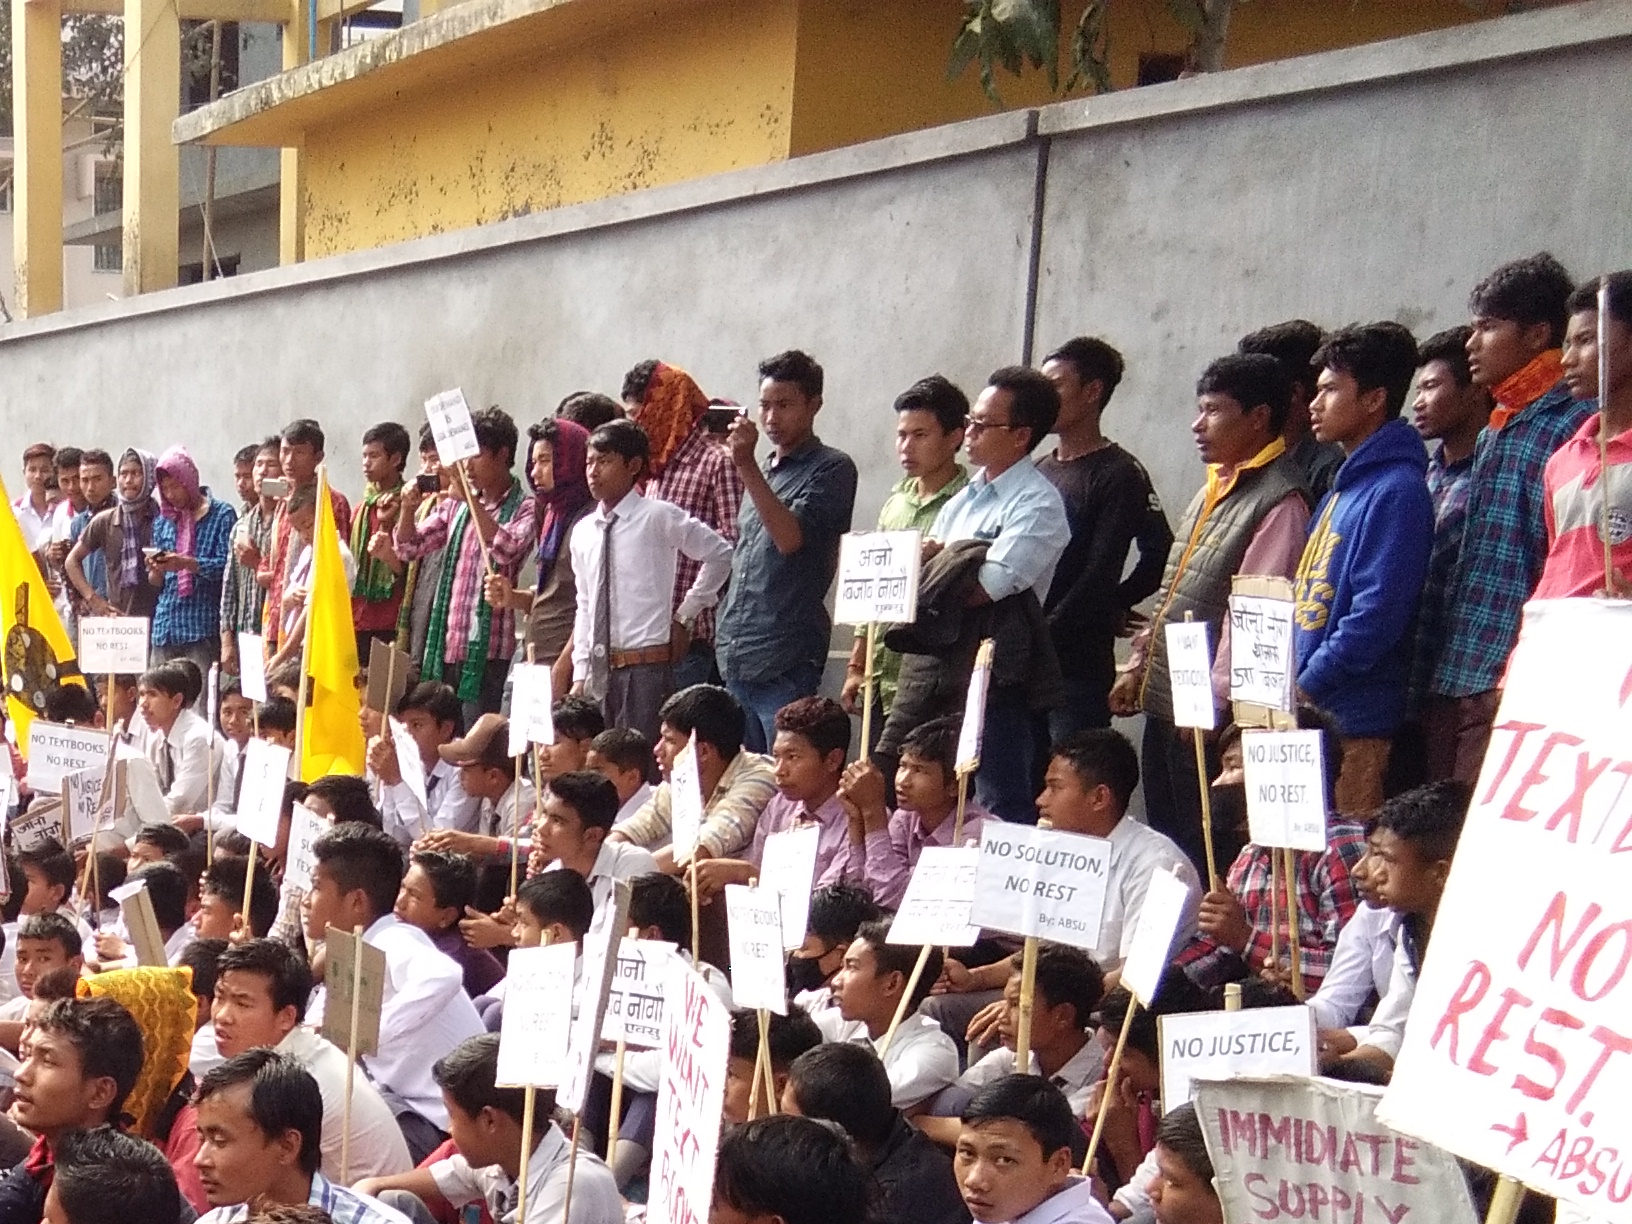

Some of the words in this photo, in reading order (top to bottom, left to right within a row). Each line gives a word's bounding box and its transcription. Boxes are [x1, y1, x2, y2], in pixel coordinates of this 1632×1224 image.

[83, 628, 95, 636] NO
[96, 642, 108, 651] NO
[31, 734, 47, 745] NO
[46, 754, 61, 766] NO
[1248, 744, 1265, 763] NO
[1259, 785, 1277, 803] NO
[984, 840, 1012, 857] NO
[1015, 845, 1104, 878] SOLUTION,
[1005, 875, 1030, 893] NO
[1033, 881, 1077, 903] REST
[1058, 918, 1087, 932] ABSU
[1518, 891, 1632, 1002] NO
[685, 974, 709, 1048] WE
[1171, 1037, 1203, 1059] NO
[1209, 1031, 1302, 1058] JUSTICE,
[1218, 1108, 1420, 1184] IMMIDIATE
[1531, 1128, 1632, 1203] ABSU
